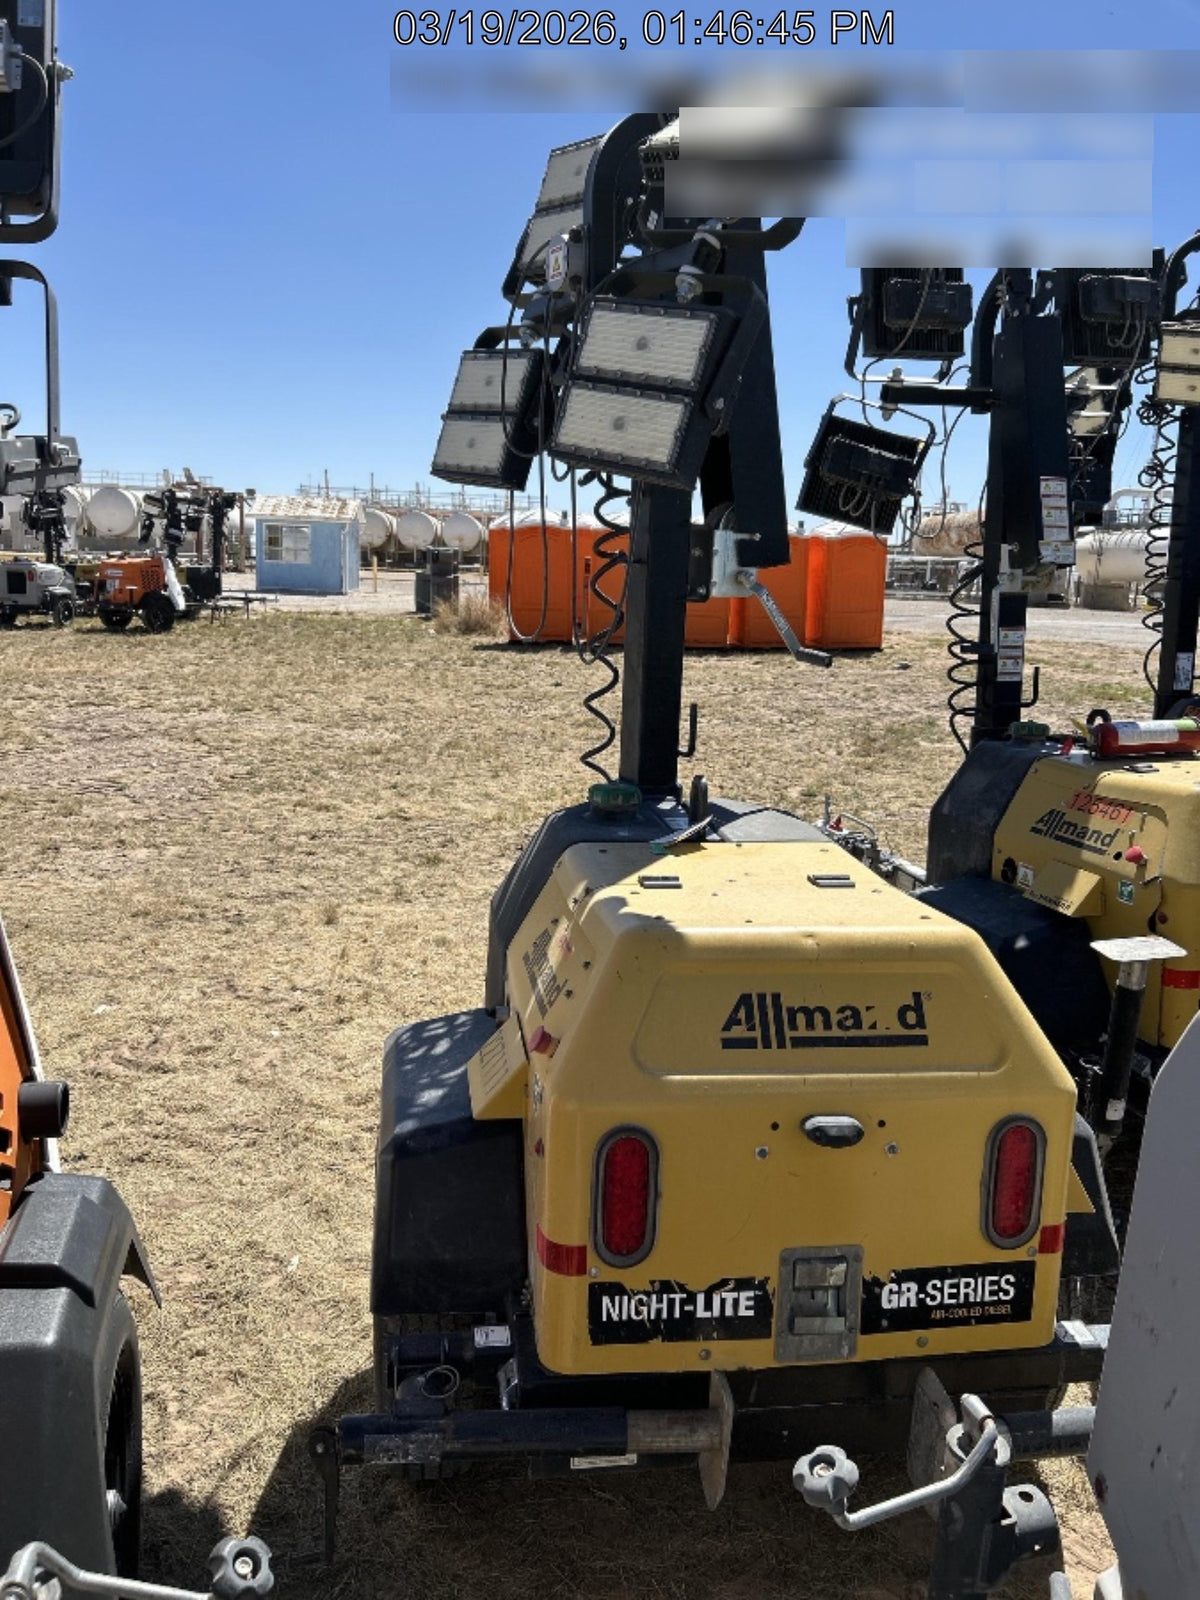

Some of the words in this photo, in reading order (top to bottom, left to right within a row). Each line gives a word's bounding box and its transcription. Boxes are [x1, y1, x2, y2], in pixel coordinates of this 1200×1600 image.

[1030, 808, 1121, 854] Allmand
[721, 991, 928, 1050] Allmad
[601, 1290, 756, 1322] NIGHT-LITE
[881, 1274, 1016, 1309] GR-SERIES
